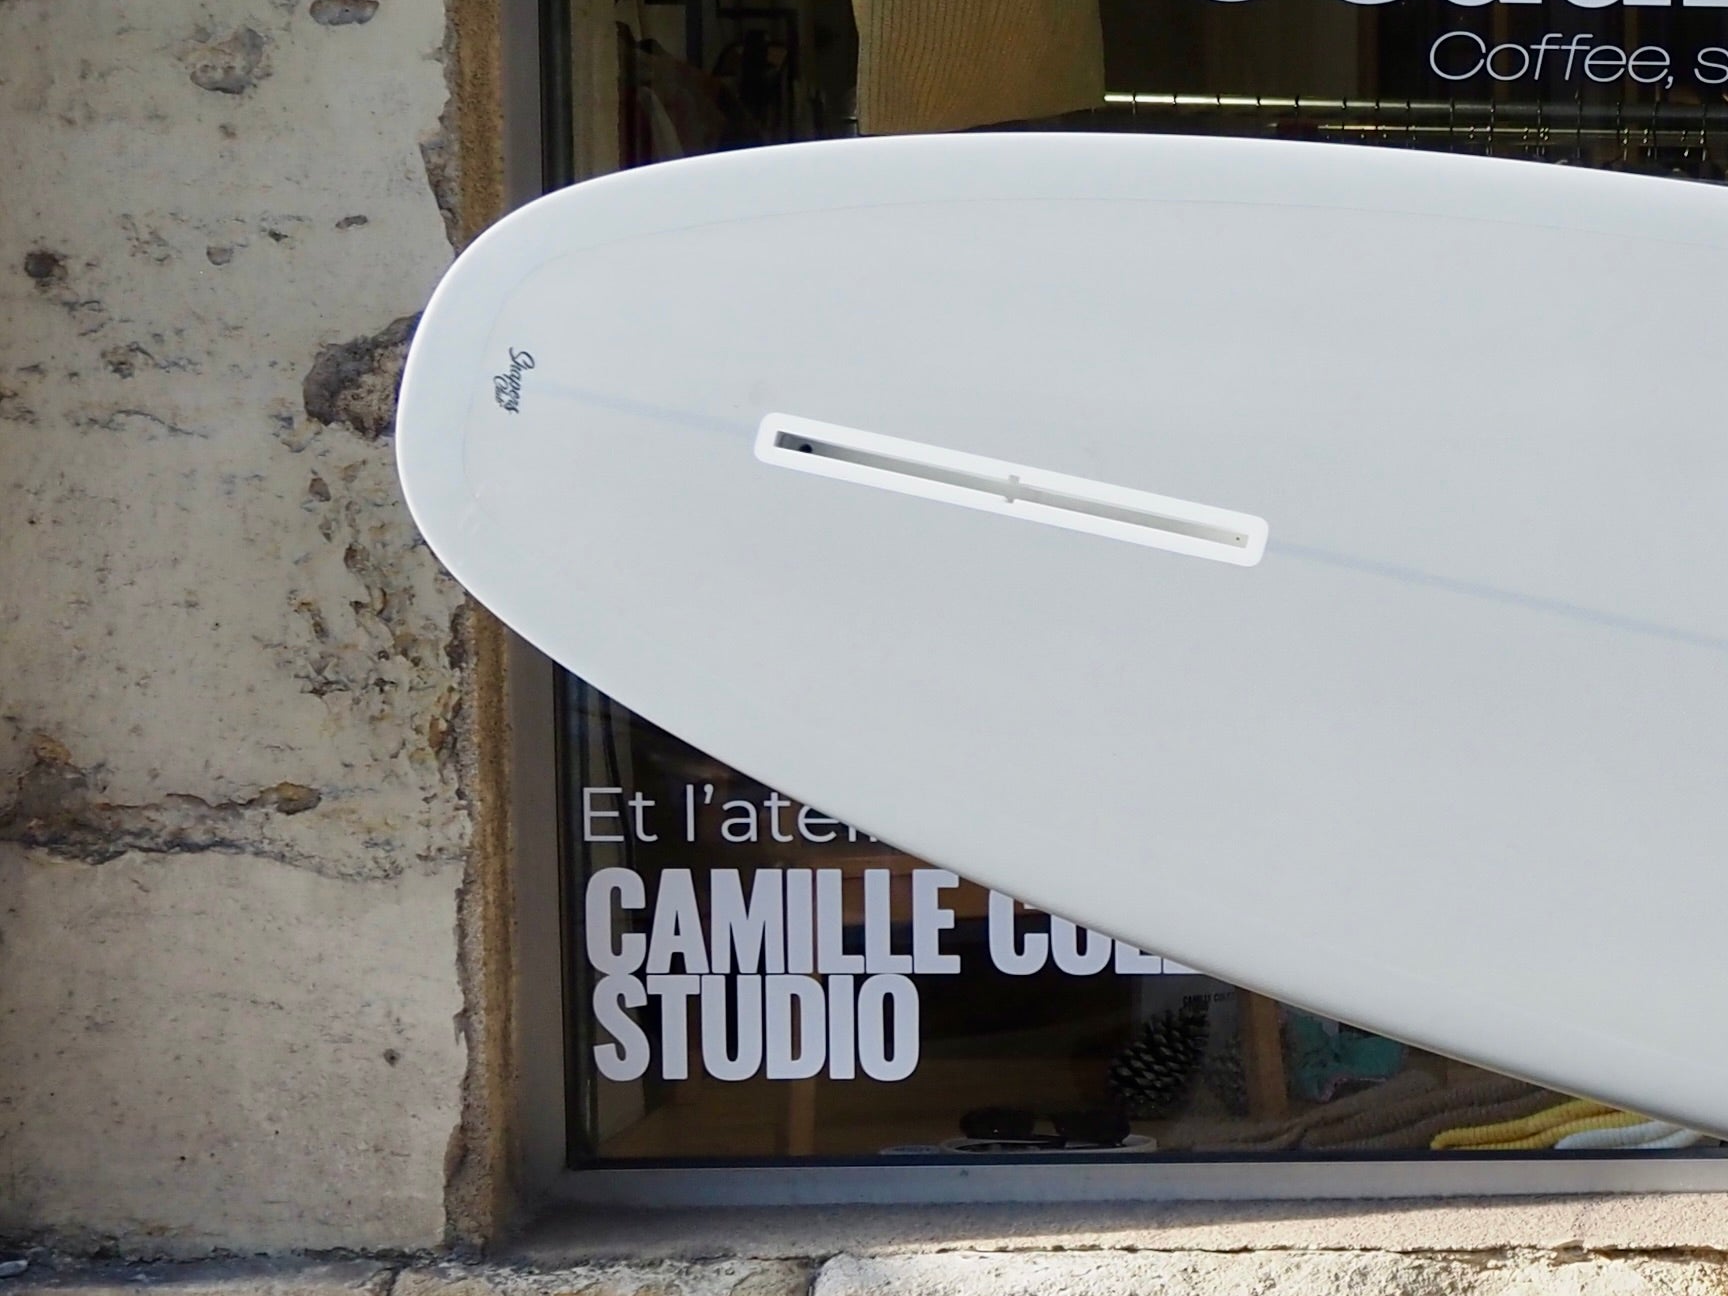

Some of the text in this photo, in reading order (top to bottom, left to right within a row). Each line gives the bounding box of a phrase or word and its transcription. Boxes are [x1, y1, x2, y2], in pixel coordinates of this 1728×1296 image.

[1430, 32, 1674, 89] Coffee,
[583, 787, 658, 843] Et
[586, 867, 961, 975] CAMILLE
[593, 971, 919, 1081] STUDIO
